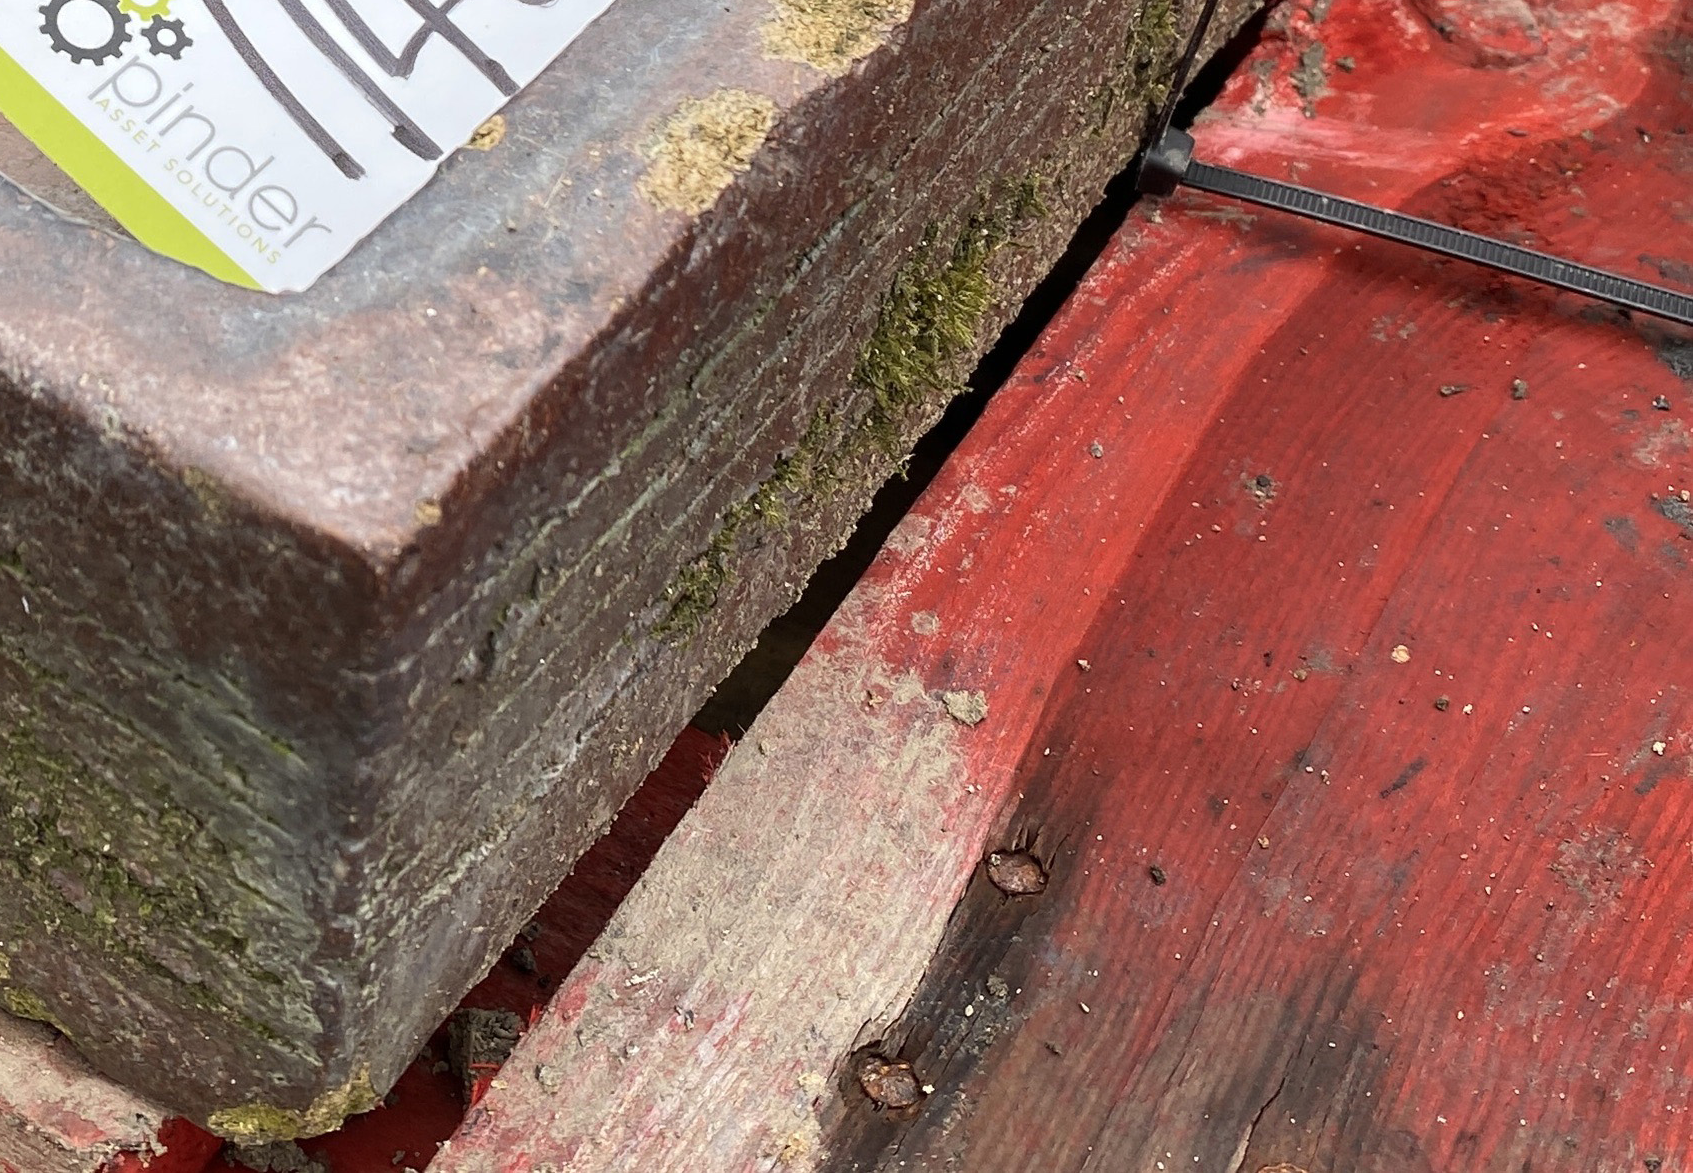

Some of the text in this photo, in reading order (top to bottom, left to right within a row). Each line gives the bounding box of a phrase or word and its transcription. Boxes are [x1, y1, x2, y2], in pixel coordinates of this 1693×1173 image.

[87, 55, 332, 249] pinder
[94, 98, 282, 265] ASSET SOLUTIONS
